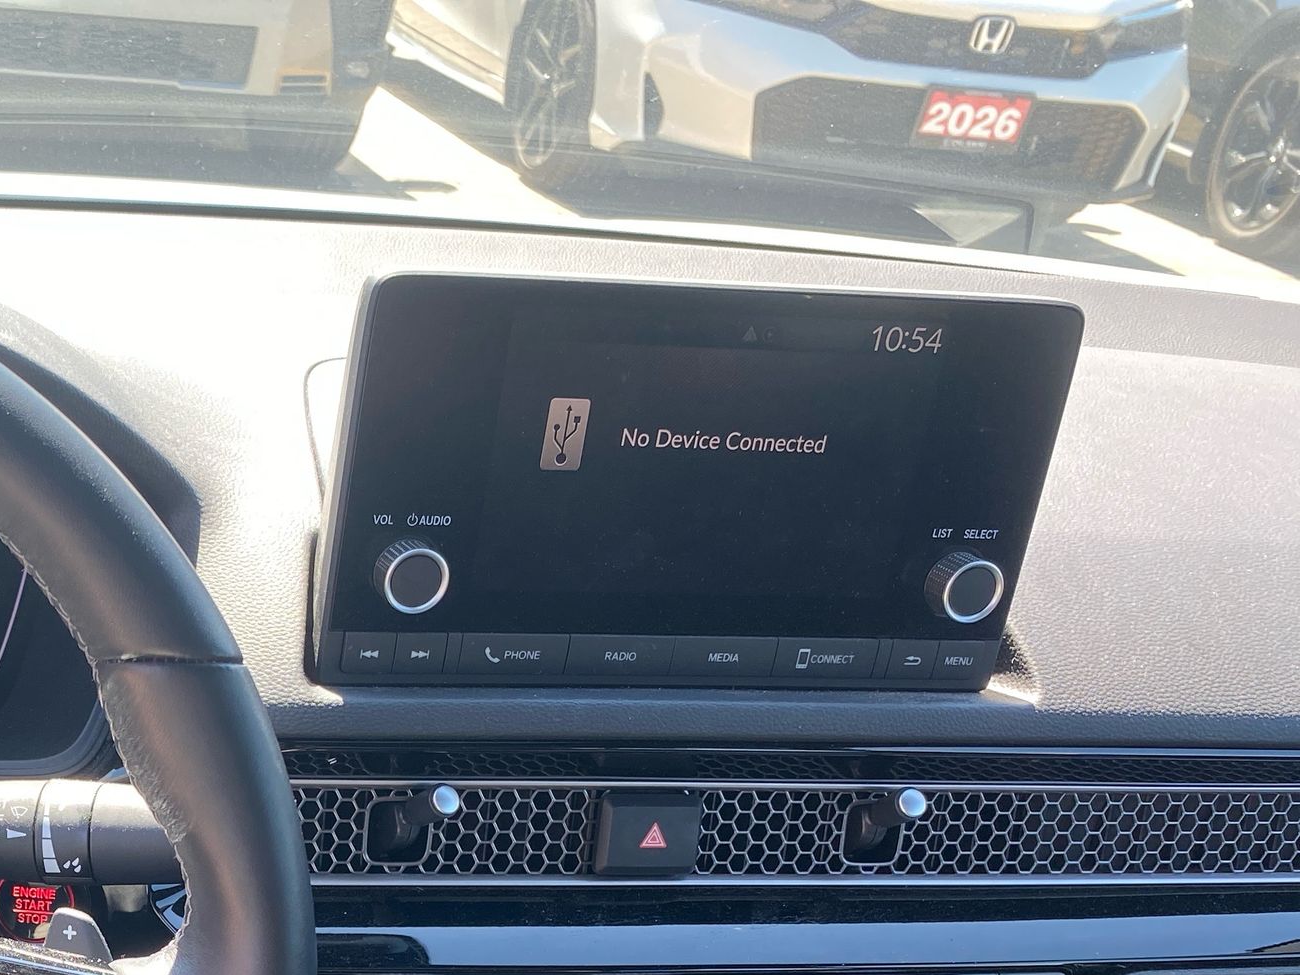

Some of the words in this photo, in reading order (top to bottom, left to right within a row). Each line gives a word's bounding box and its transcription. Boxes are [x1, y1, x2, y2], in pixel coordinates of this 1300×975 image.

[919, 101, 1022, 140] 2026
[872, 325, 943, 354] 10:54
[620, 428, 649, 447] No
[655, 429, 720, 450] Device
[725, 431, 828, 454] Connected
[373, 514, 394, 525] VOL
[419, 515, 452, 527] AUDIO
[932, 528, 953, 539] LIST
[963, 529, 999, 540] SELECT
[504, 650, 541, 661] PHONE
[604, 651, 637, 662] RADIO
[708, 653, 739, 664] MEDIA
[811, 654, 855, 665] CONNECT
[944, 656, 974, 667] MENU
[12, 886, 56, 900] ENGINE
[15, 898, 52, 911] START
[17, 913, 48, 924] STOP
